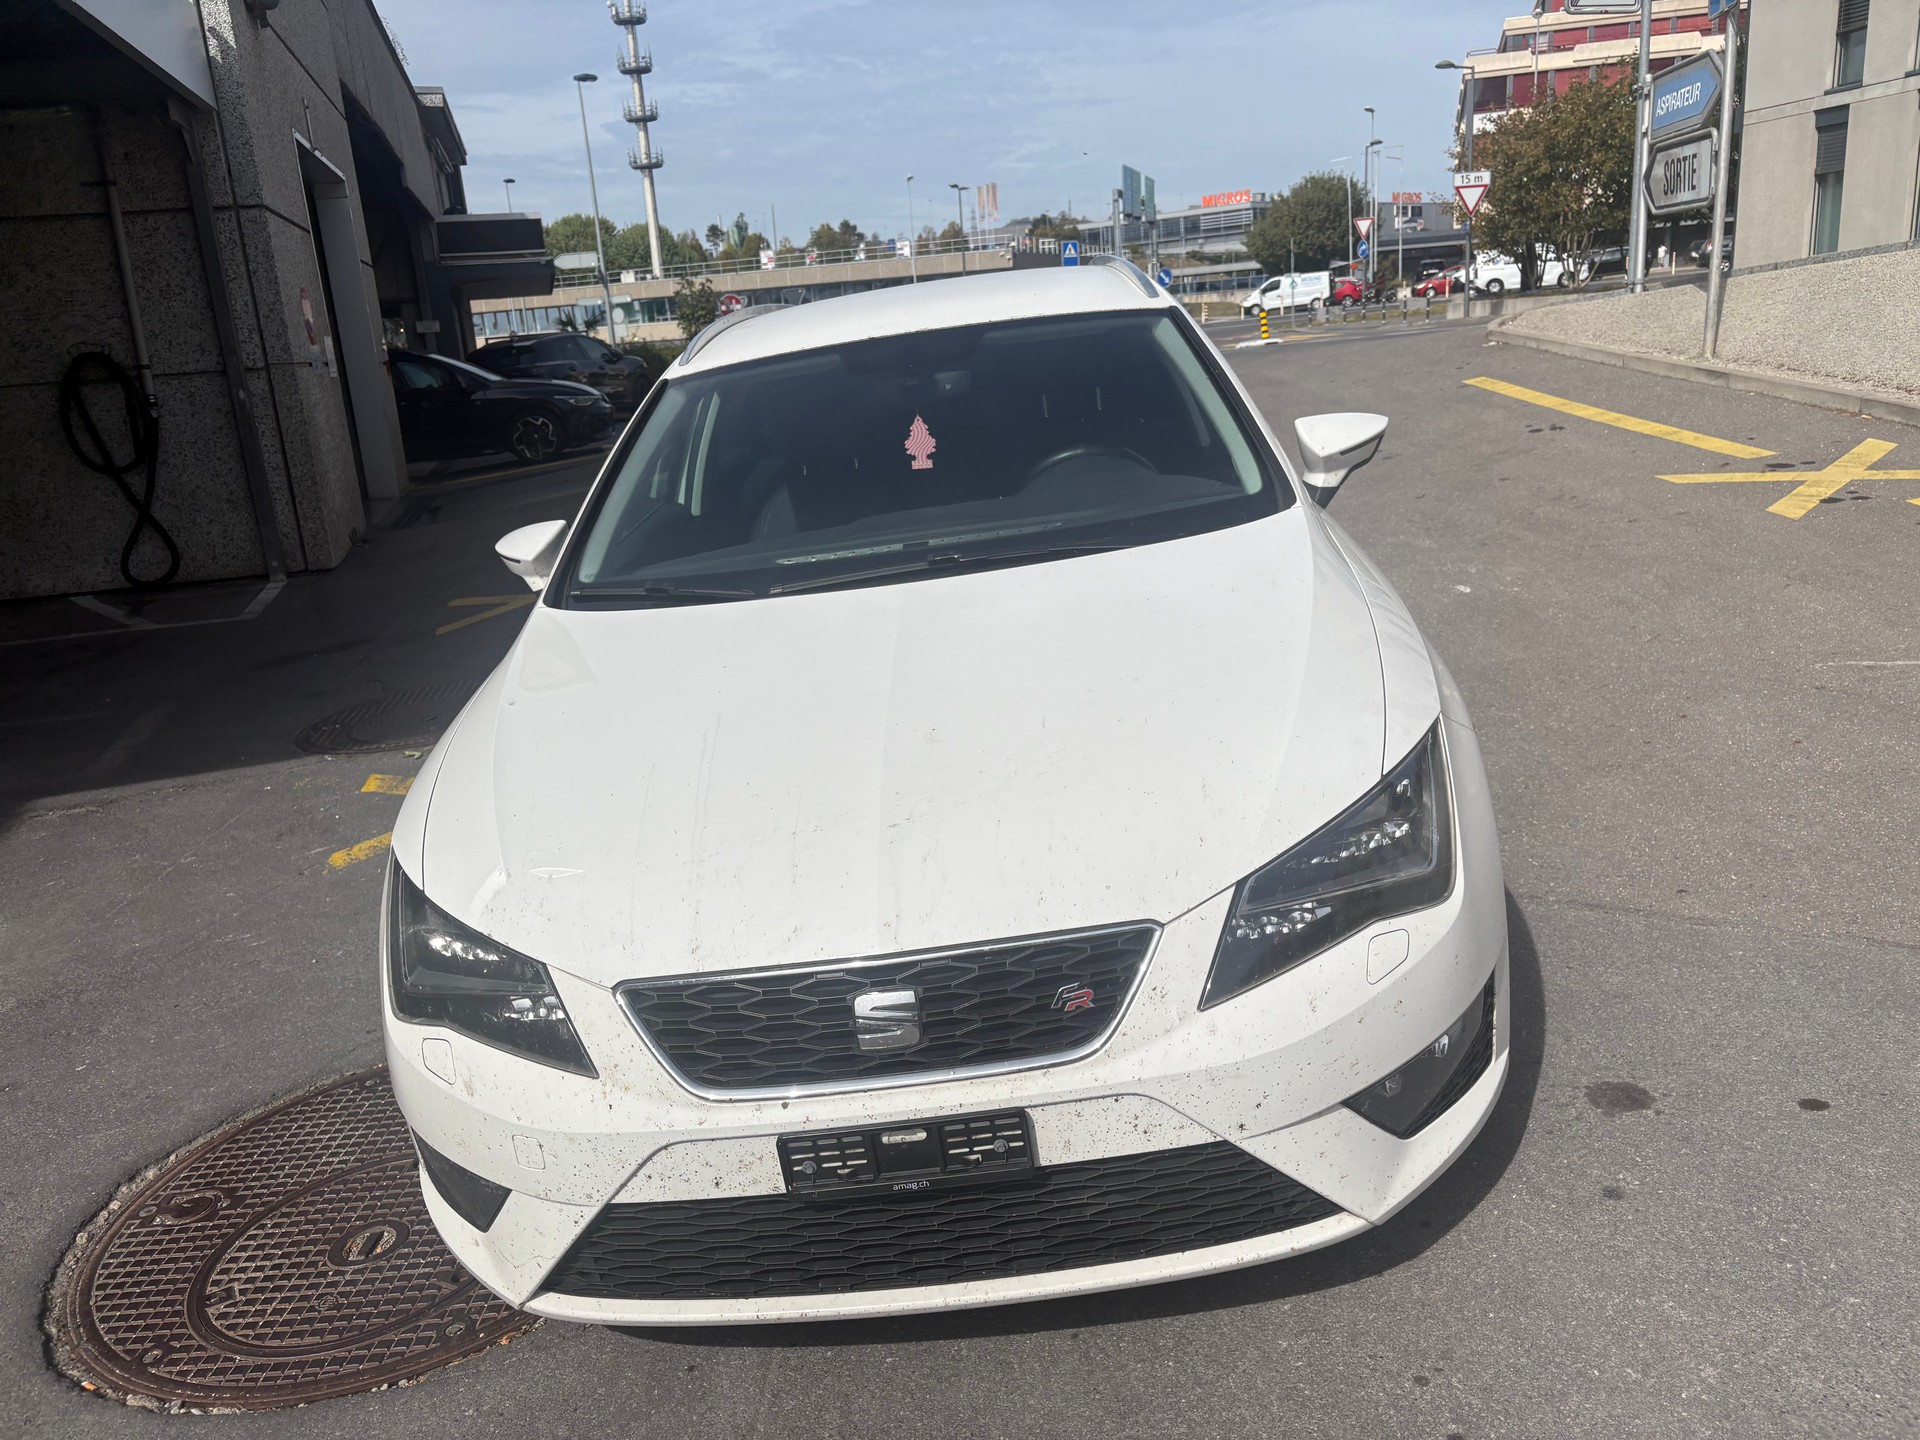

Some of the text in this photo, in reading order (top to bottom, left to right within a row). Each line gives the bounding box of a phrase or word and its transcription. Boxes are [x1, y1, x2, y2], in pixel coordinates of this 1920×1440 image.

[1656, 82, 1702, 117] ASPIRATEUR
[1461, 174, 1483, 184] 15 m
[1663, 153, 1698, 196] SORTIE
[1202, 189, 1251, 208] MIGROS
[1392, 191, 1422, 203] MGROS
[893, 1181, 930, 1191] amag.ch
